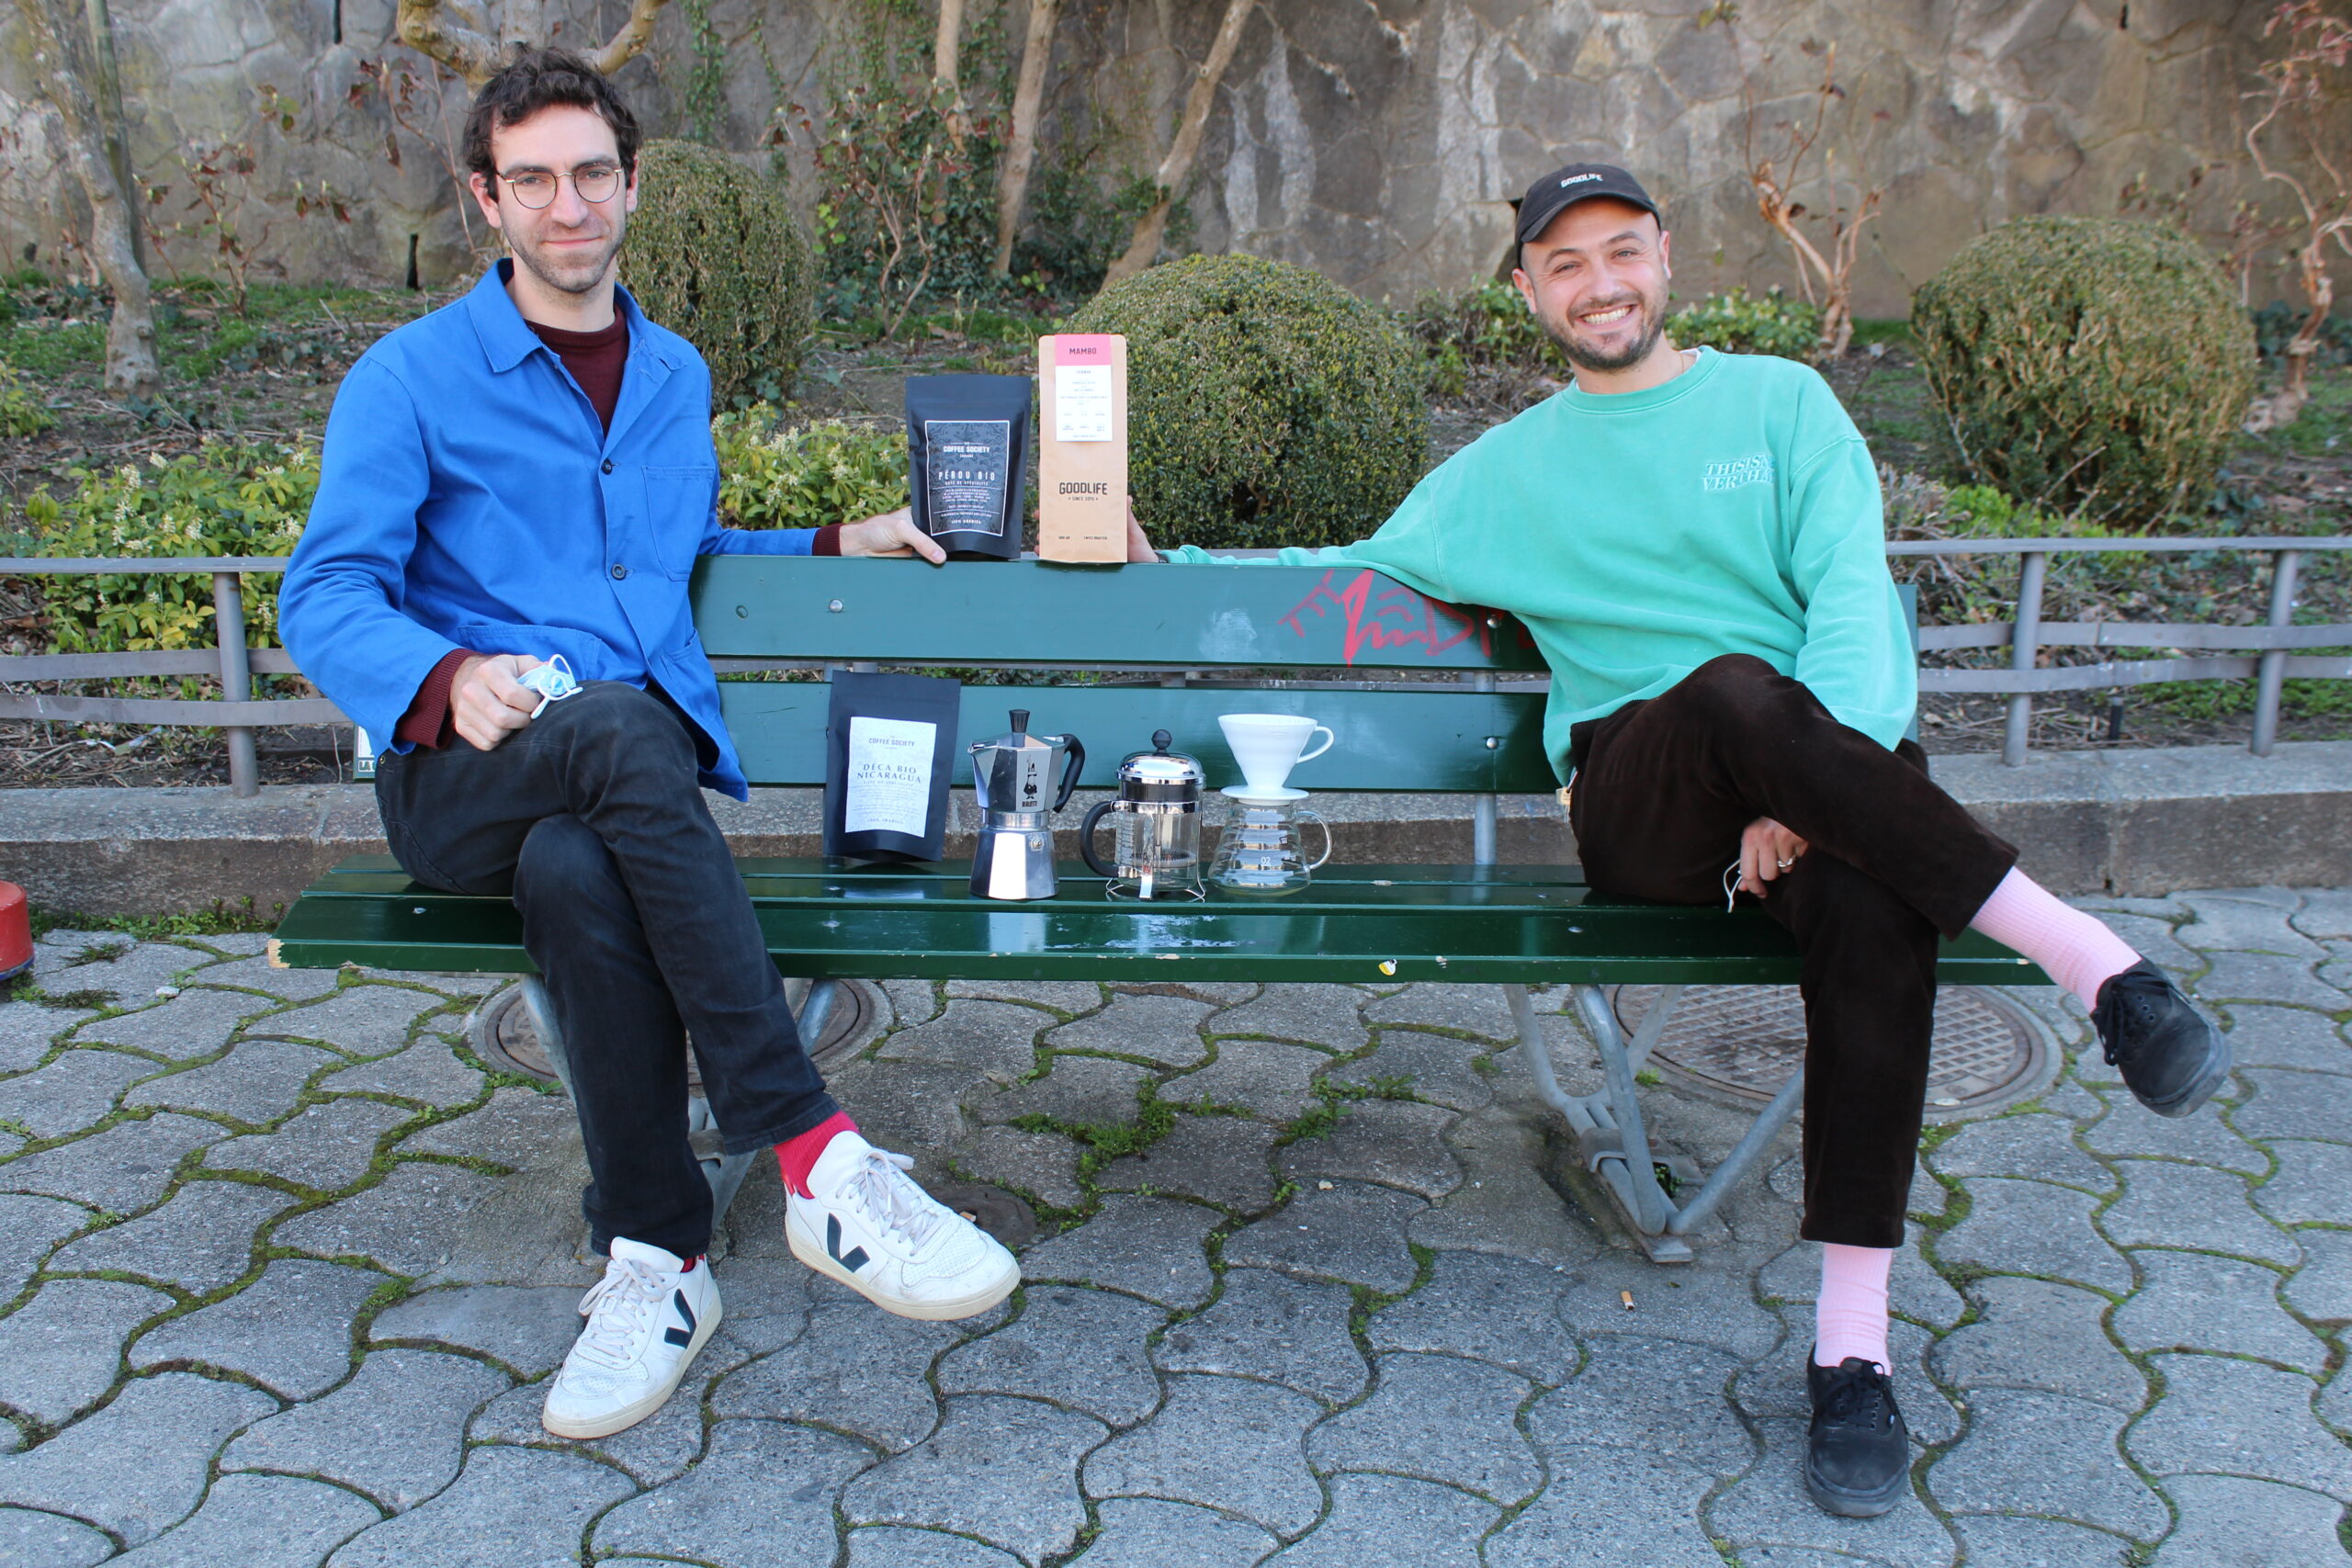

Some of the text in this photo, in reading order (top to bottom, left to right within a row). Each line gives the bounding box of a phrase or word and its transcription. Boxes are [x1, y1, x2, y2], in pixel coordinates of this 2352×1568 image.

[1560, 173, 1603, 188] GOODLIFE
[1069, 347, 1097, 355] MAMBO
[938, 469, 995, 480] PÉROU BIO
[1058, 482, 1108, 495] GOODLIFE
[891, 739, 915, 747] SOCIETY
[897, 764, 916, 774] BIO
[857, 772, 921, 784] NICARAGUA
[1261, 856, 1271, 864] 02
